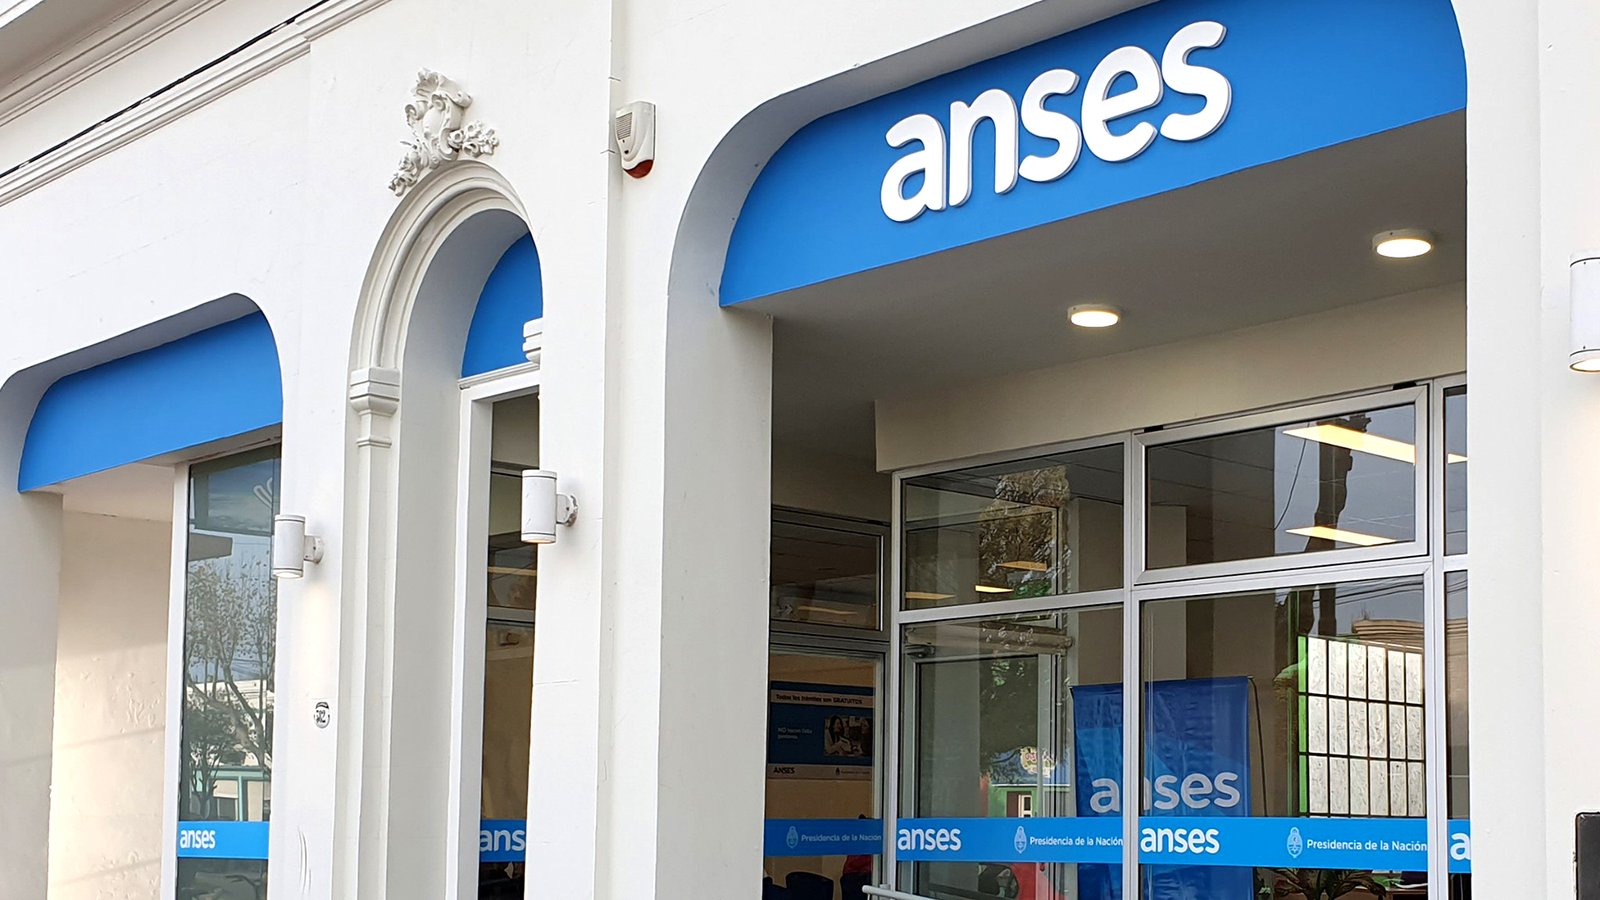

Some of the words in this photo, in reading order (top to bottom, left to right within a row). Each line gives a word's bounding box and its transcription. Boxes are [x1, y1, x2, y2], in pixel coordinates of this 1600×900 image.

[880, 20, 1232, 222] anses
[1090, 772, 1240, 813] ases
[180, 829, 216, 849] anses
[801, 833, 840, 842] Presidencia
[841, 833, 850, 842] de
[851, 833, 858, 841] la
[859, 833, 882, 841] Nación
[897, 828, 962, 851] anses
[1029, 836, 1073, 846] Presidencia
[1075, 836, 1085, 846] de
[1087, 836, 1094, 846] la
[1095, 836, 1123, 846] Nación
[1140, 828, 1220, 854] anses
[1306, 839, 1362, 850] Presidencia
[1364, 840, 1378, 850] de
[1380, 840, 1389, 850] la
[1391, 840, 1427, 851] Nación
